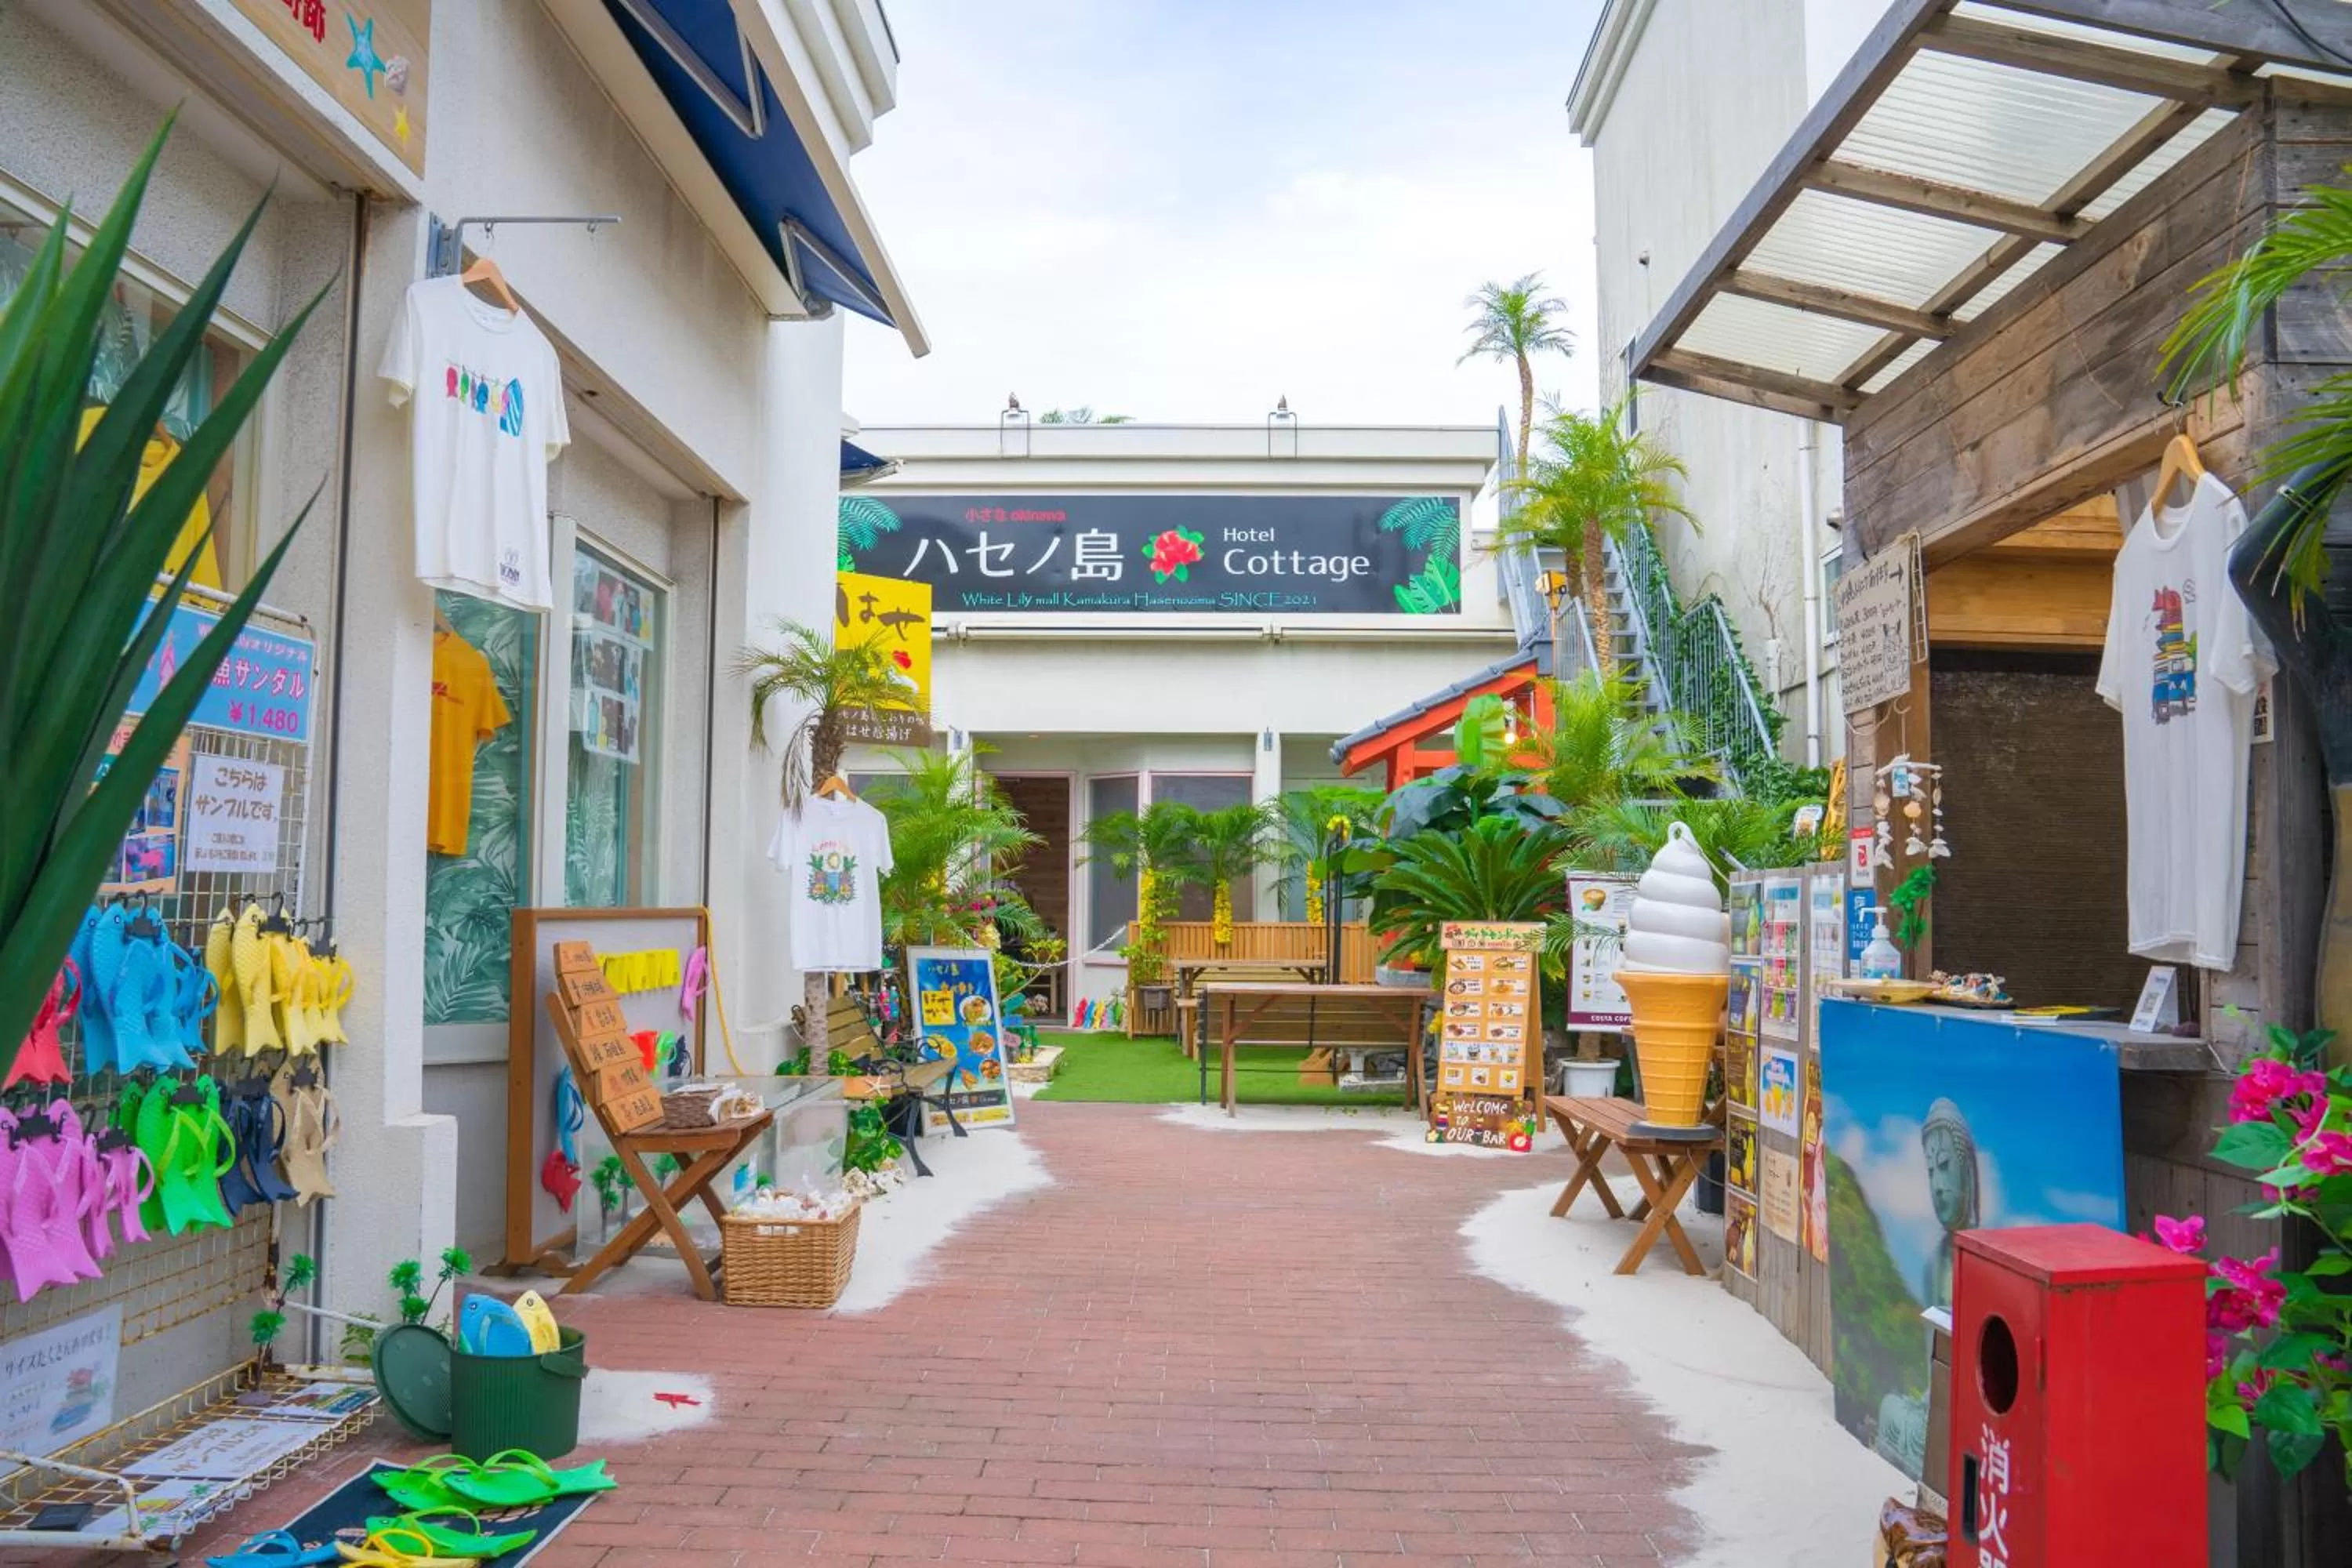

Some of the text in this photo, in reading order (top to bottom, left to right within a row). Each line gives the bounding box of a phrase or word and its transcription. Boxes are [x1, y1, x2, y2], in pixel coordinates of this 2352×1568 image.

[1223, 527, 1276, 543] Hotel
[902, 528, 1125, 583] ハセノ島
[1223, 548, 1370, 583] Cottage
[961, 592, 1004, 607] White
[1007, 592, 1033, 608] Lily
[1036, 592, 1059, 606] mall
[1063, 592, 1131, 607] Kamakura
[1218, 592, 1283, 608] SINCE
[214, 766, 268, 792] こちらは
[1446, 1127, 1475, 1142] OUR
